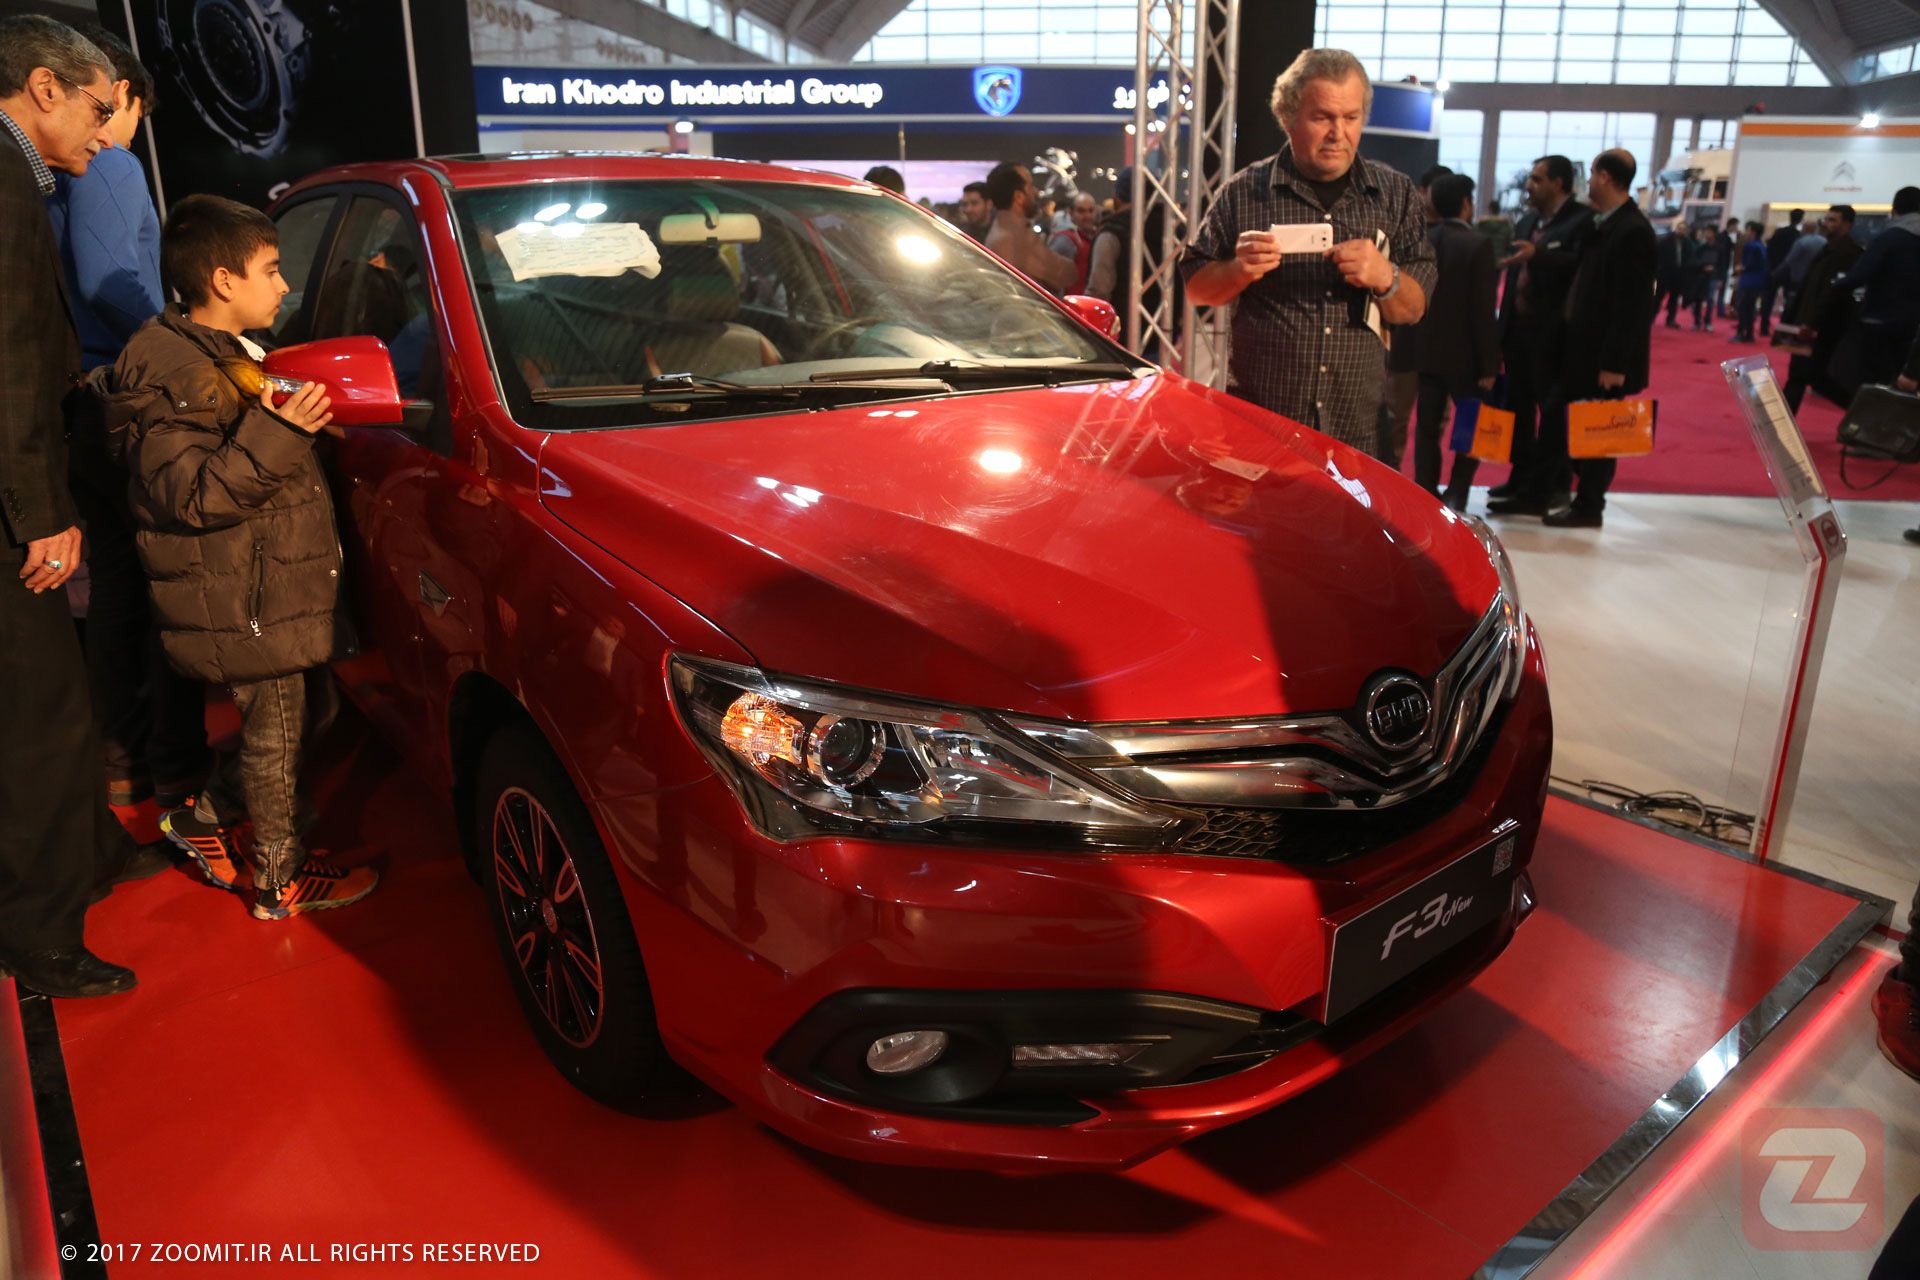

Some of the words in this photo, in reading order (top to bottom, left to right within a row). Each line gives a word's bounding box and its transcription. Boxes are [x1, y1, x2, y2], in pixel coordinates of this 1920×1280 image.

[502, 77, 556, 104] Iran
[562, 78, 664, 105] Khodro
[670, 79, 795, 104] Industrial
[801, 78, 883, 108] Group
[1375, 692, 1425, 735] BYD
[1380, 893, 1448, 961] F3
